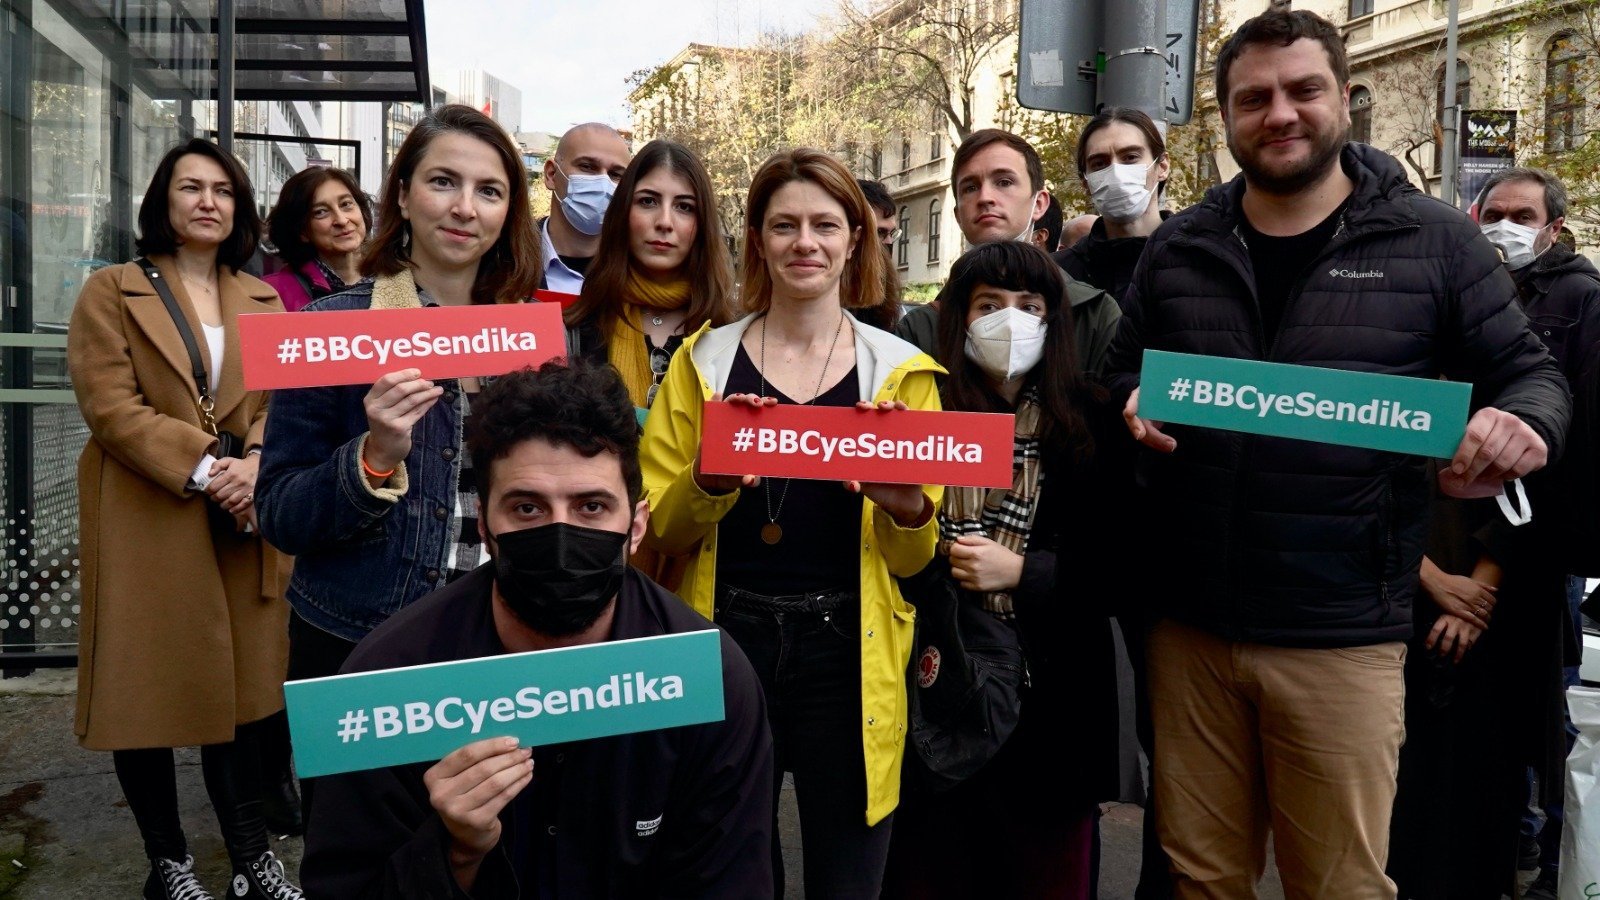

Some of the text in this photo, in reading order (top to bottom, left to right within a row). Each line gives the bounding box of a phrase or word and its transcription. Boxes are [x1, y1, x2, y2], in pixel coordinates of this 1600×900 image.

[1340, 269, 1384, 278] Columbia
[277, 327, 537, 365] #BBCyeSendika
[1168, 378, 1431, 431] #BBCyeSendika
[732, 427, 983, 463] #BBCyeSendika
[337, 671, 684, 743] #BBCyeSendika
